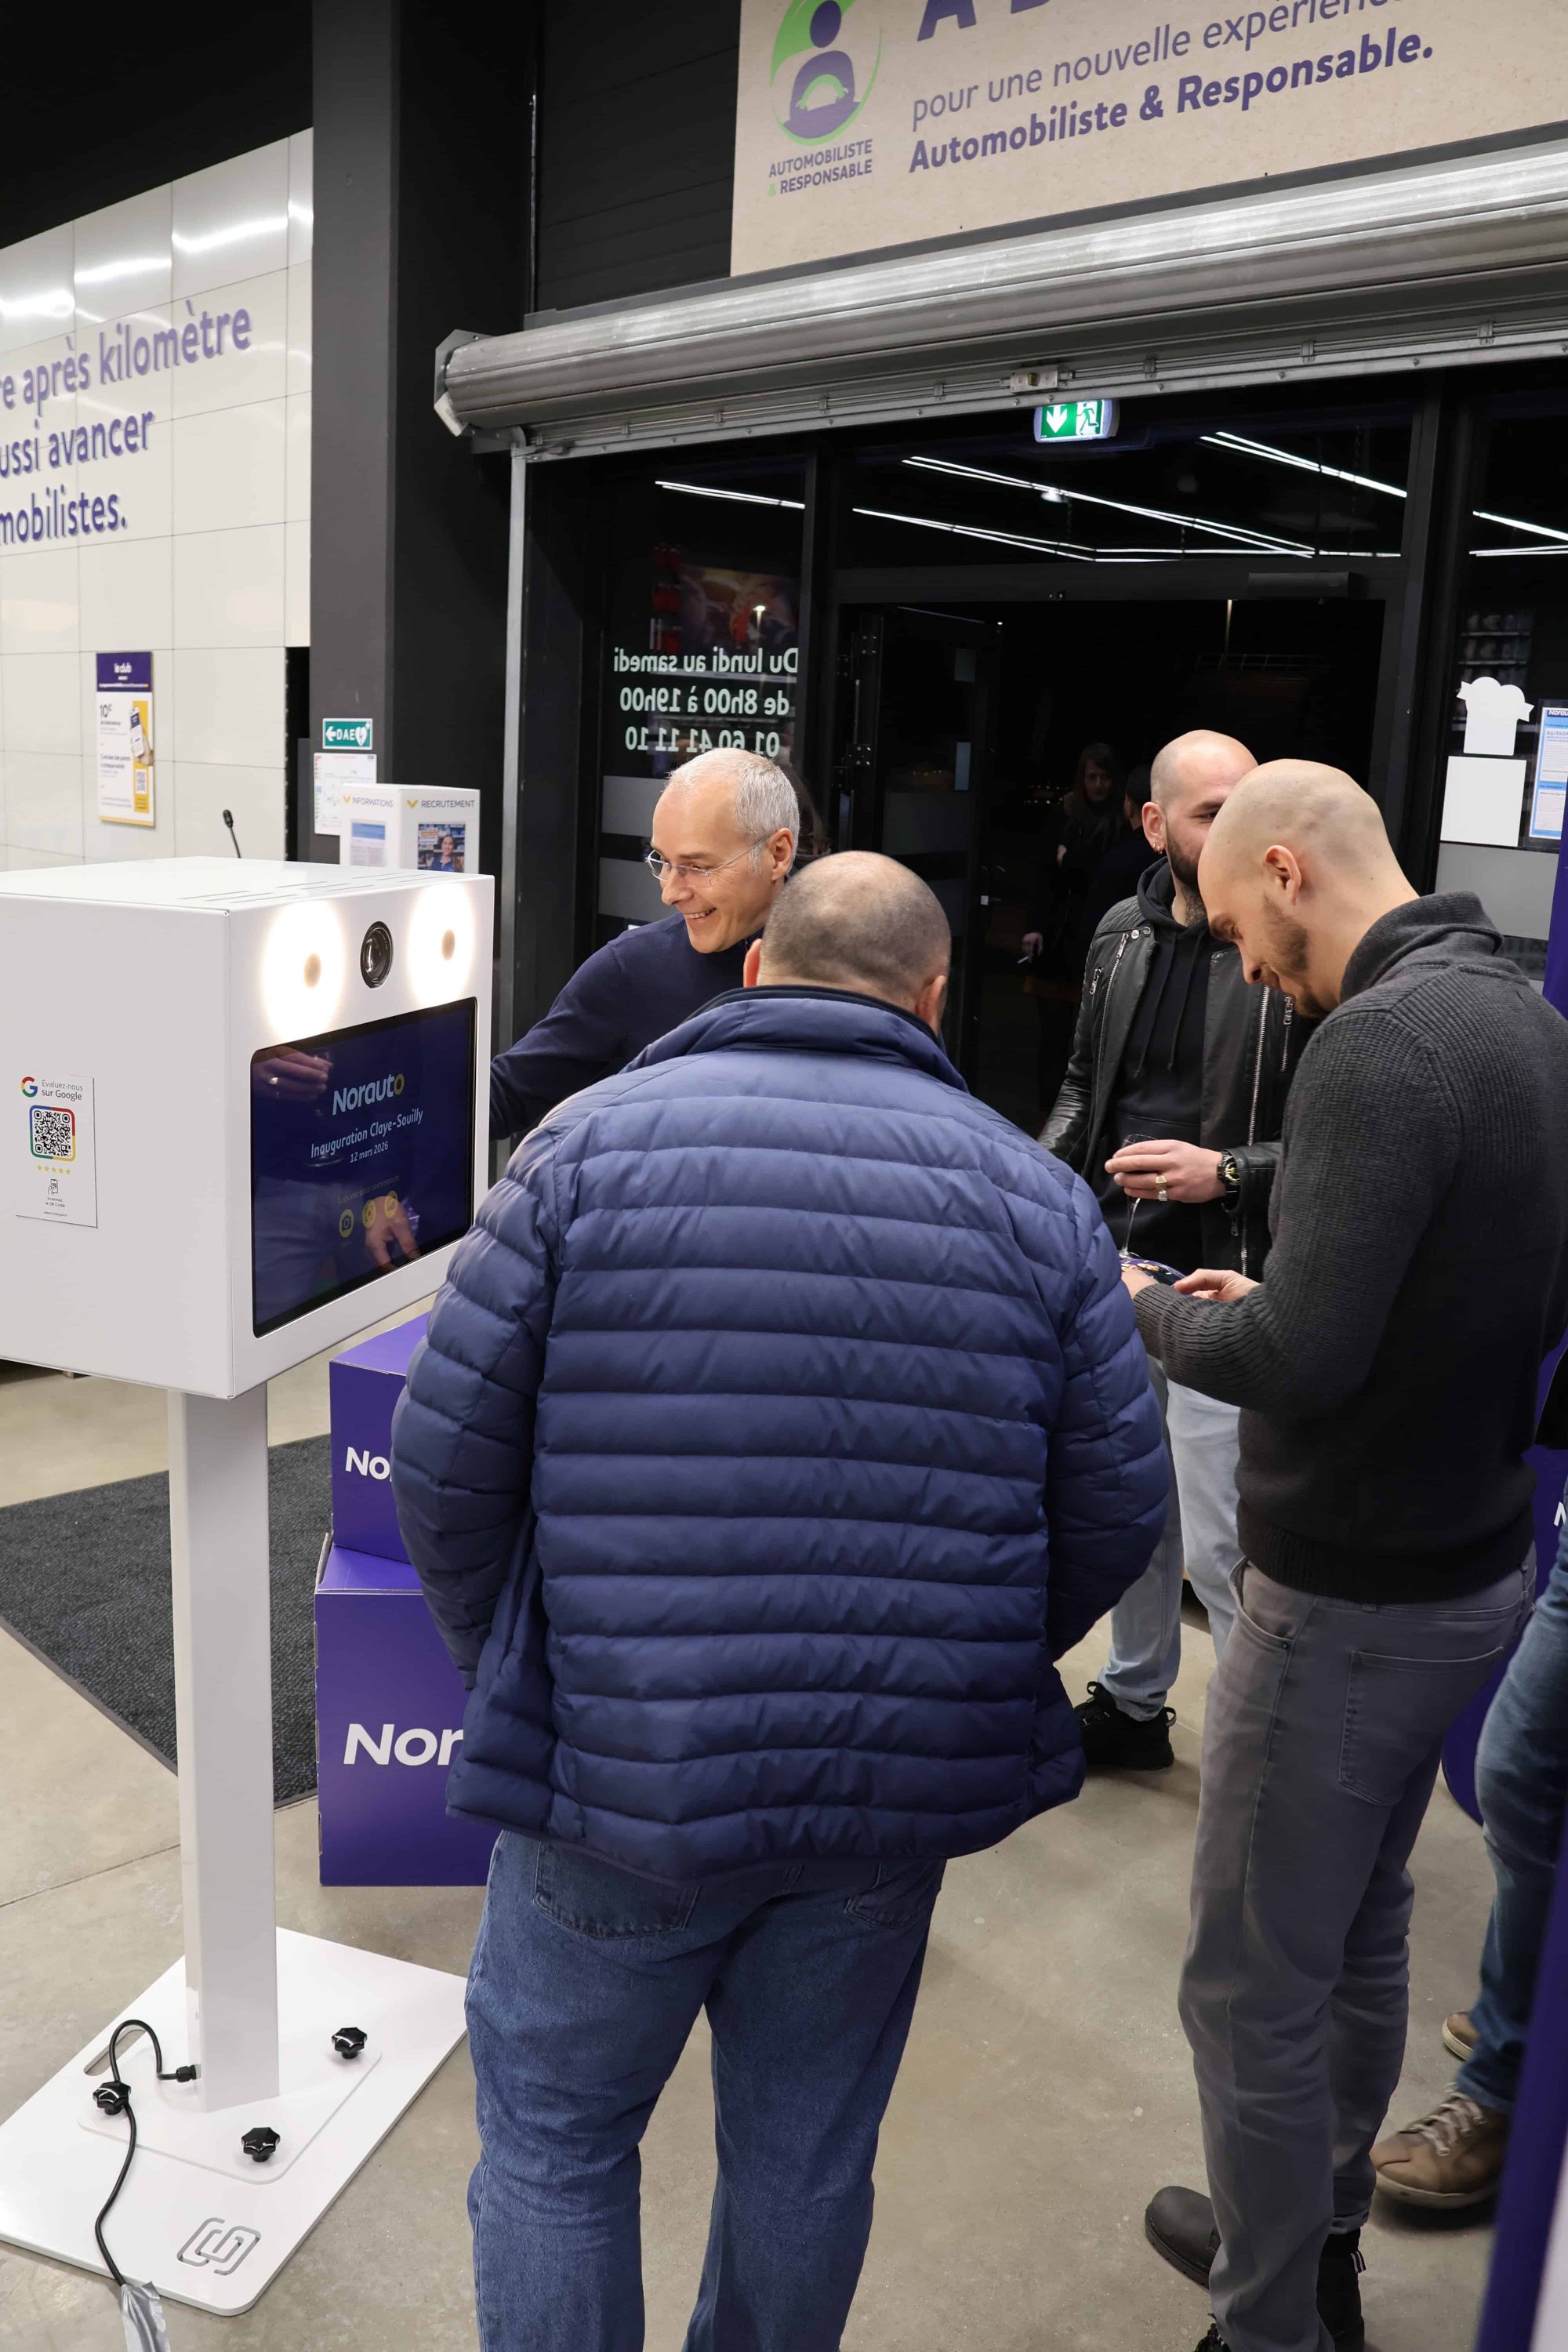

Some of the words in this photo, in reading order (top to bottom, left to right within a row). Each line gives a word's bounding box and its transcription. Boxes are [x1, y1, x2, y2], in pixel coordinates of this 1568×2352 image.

[913, 85, 978, 132] pour
[989, 69, 1043, 103] une
[1053, 24, 1191, 87] nouvelle
[909, 100, 1127, 172] Automobiliste
[1139, 85, 1163, 121] &
[1177, 27, 1433, 113] Responsable.
[768, 139, 873, 178] AUTOMOBILISTE
[780, 159, 873, 194] RESPONSABLE
[24, 336, 91, 417] après
[99, 299, 252, 384] kilomètre
[49, 412, 154, 468] avancer
[336, 728, 356, 741] DAE
[353, 797, 394, 808] INFORMATIONS
[421, 800, 475, 808] RECRUTEMENT
[42, 1079, 83, 1091] Évaluez-nous
[55, 1089, 82, 1102] Google
[332, 1073, 405, 1116] Norauto
[310, 1127, 368, 1158] Inauguration
[370, 1108, 423, 1137] Claye-Souilly
[350, 1152, 358, 1163] 12
[359, 1149, 372, 1160] mars
[373, 1141, 388, 1154] 2026
[345, 1446, 392, 1483] No
[343, 1723, 464, 1766] Nor
